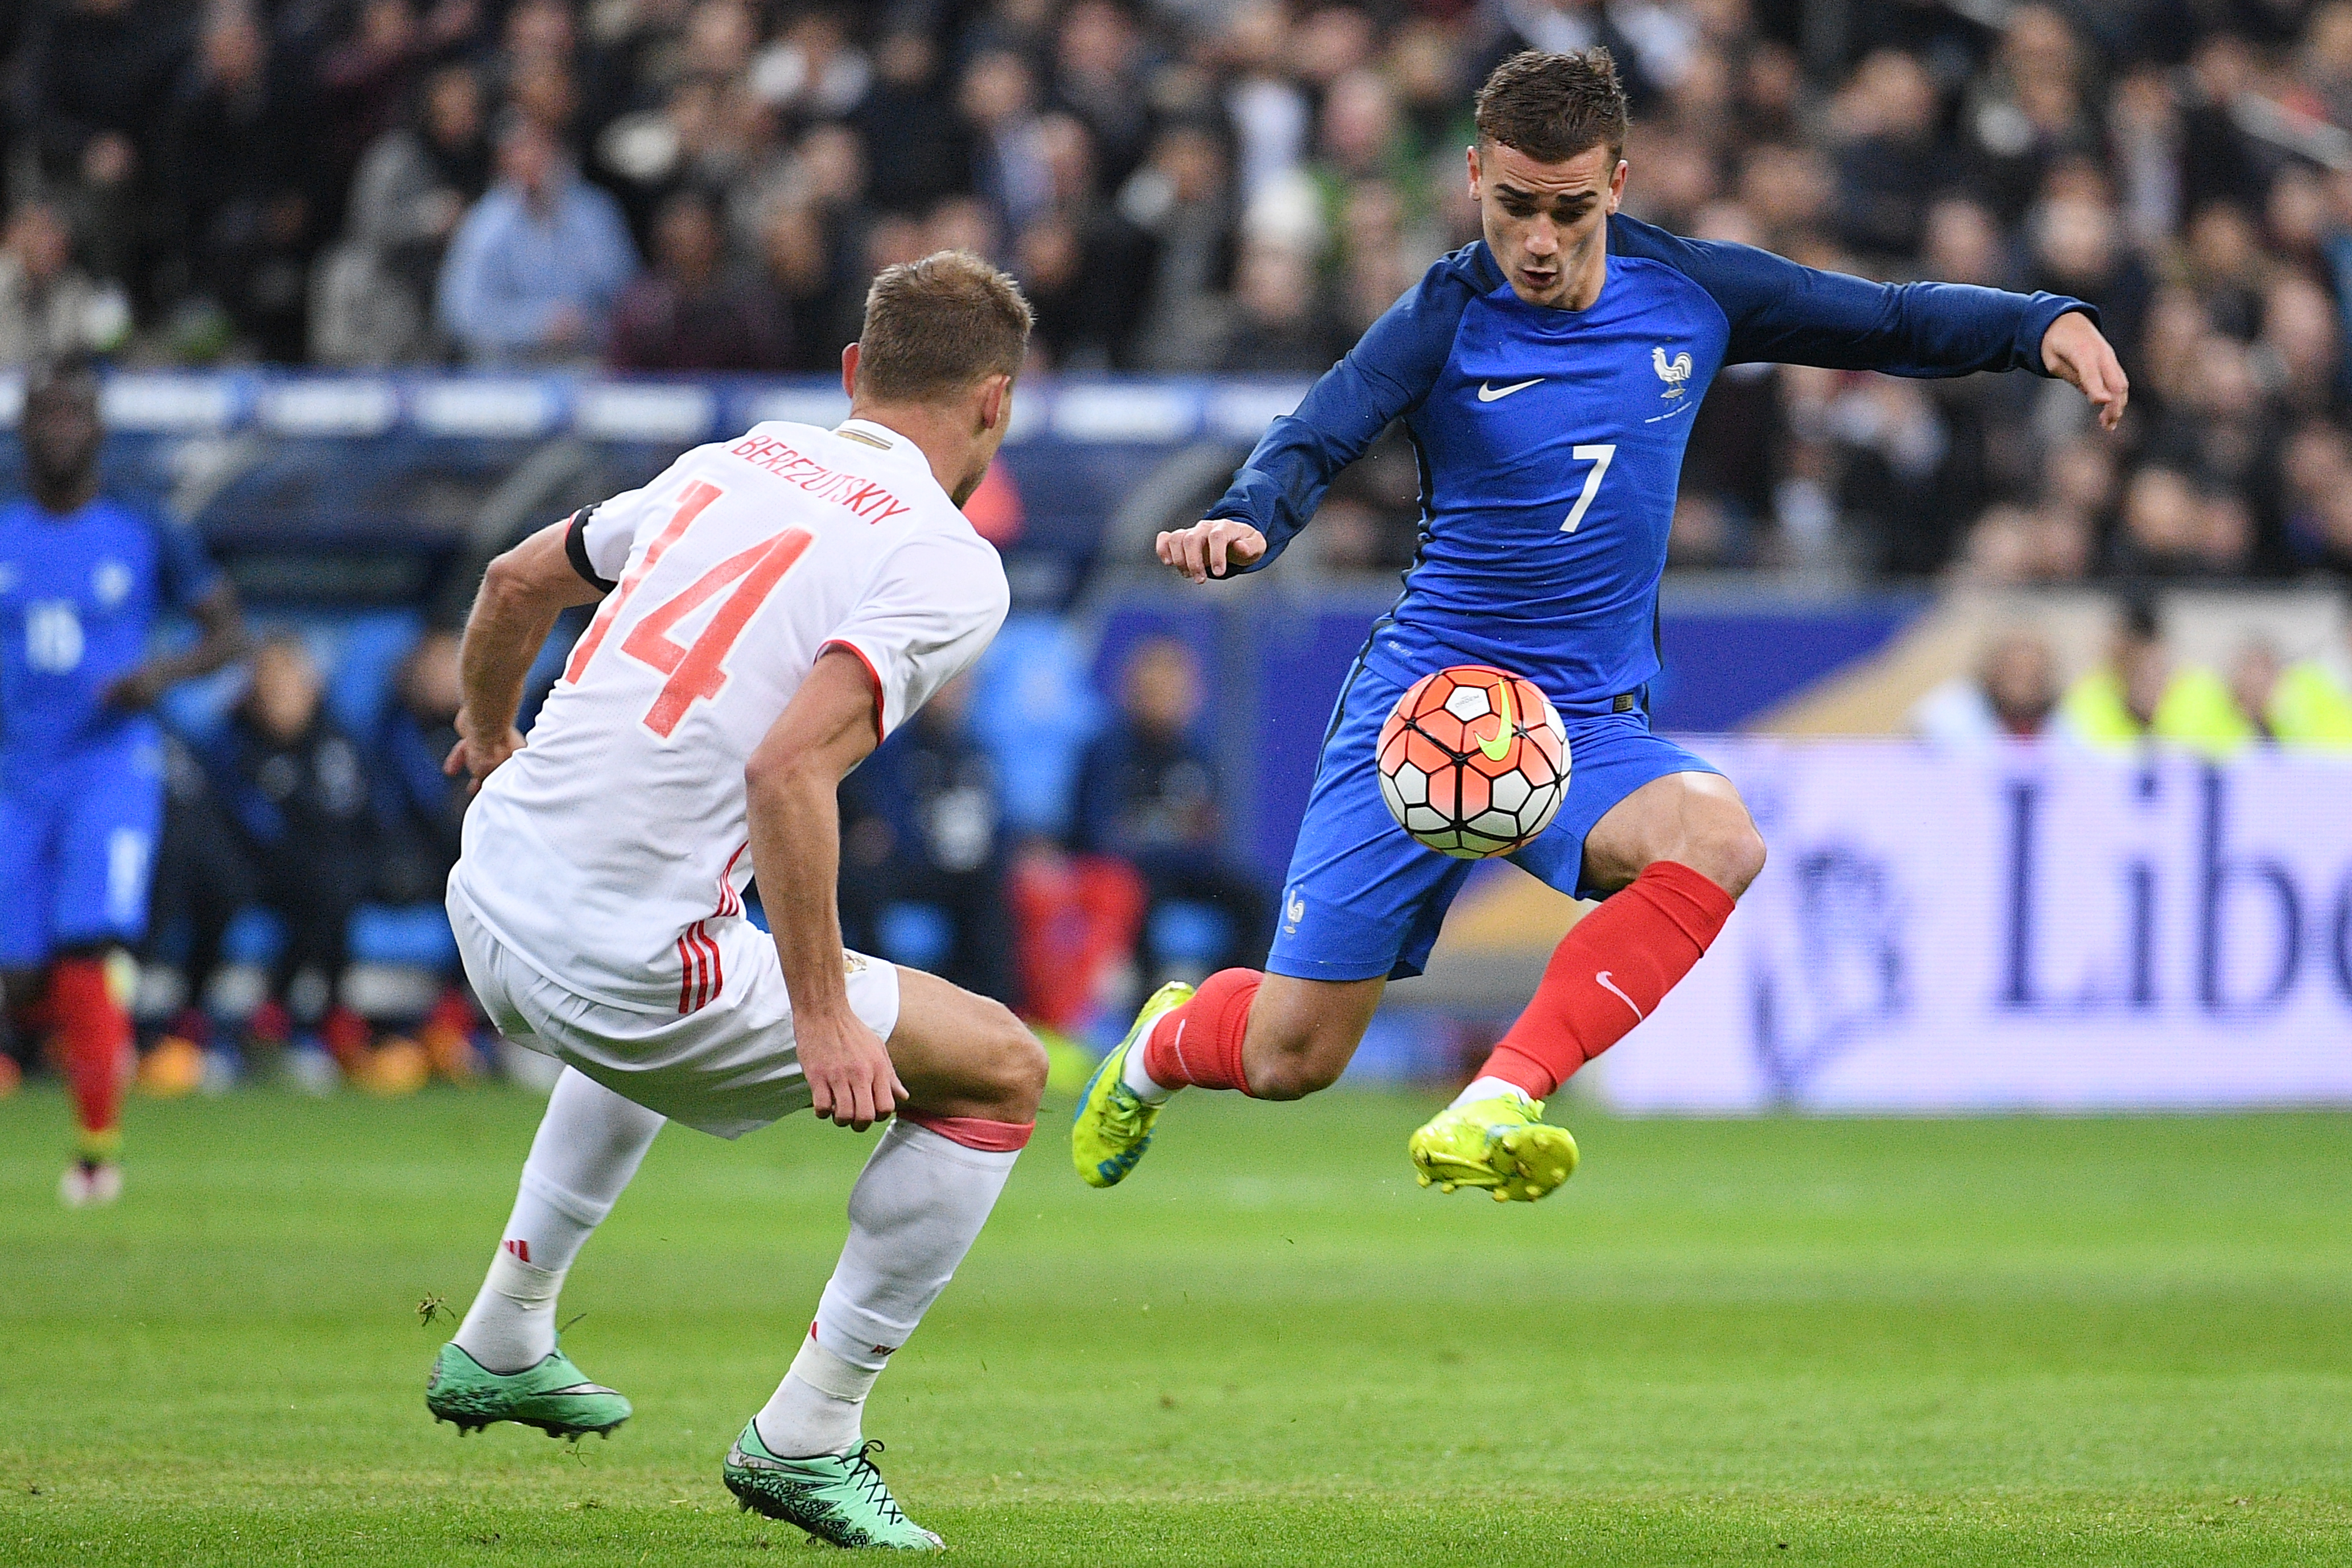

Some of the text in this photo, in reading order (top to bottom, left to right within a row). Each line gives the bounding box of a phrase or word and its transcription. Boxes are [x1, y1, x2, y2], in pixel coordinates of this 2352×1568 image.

[731, 435, 911, 525] BEREZUTSKIY
[1559, 444, 1617, 533] 7
[564, 480, 814, 739] 14
[1994, 765, 2352, 1014] Lib
